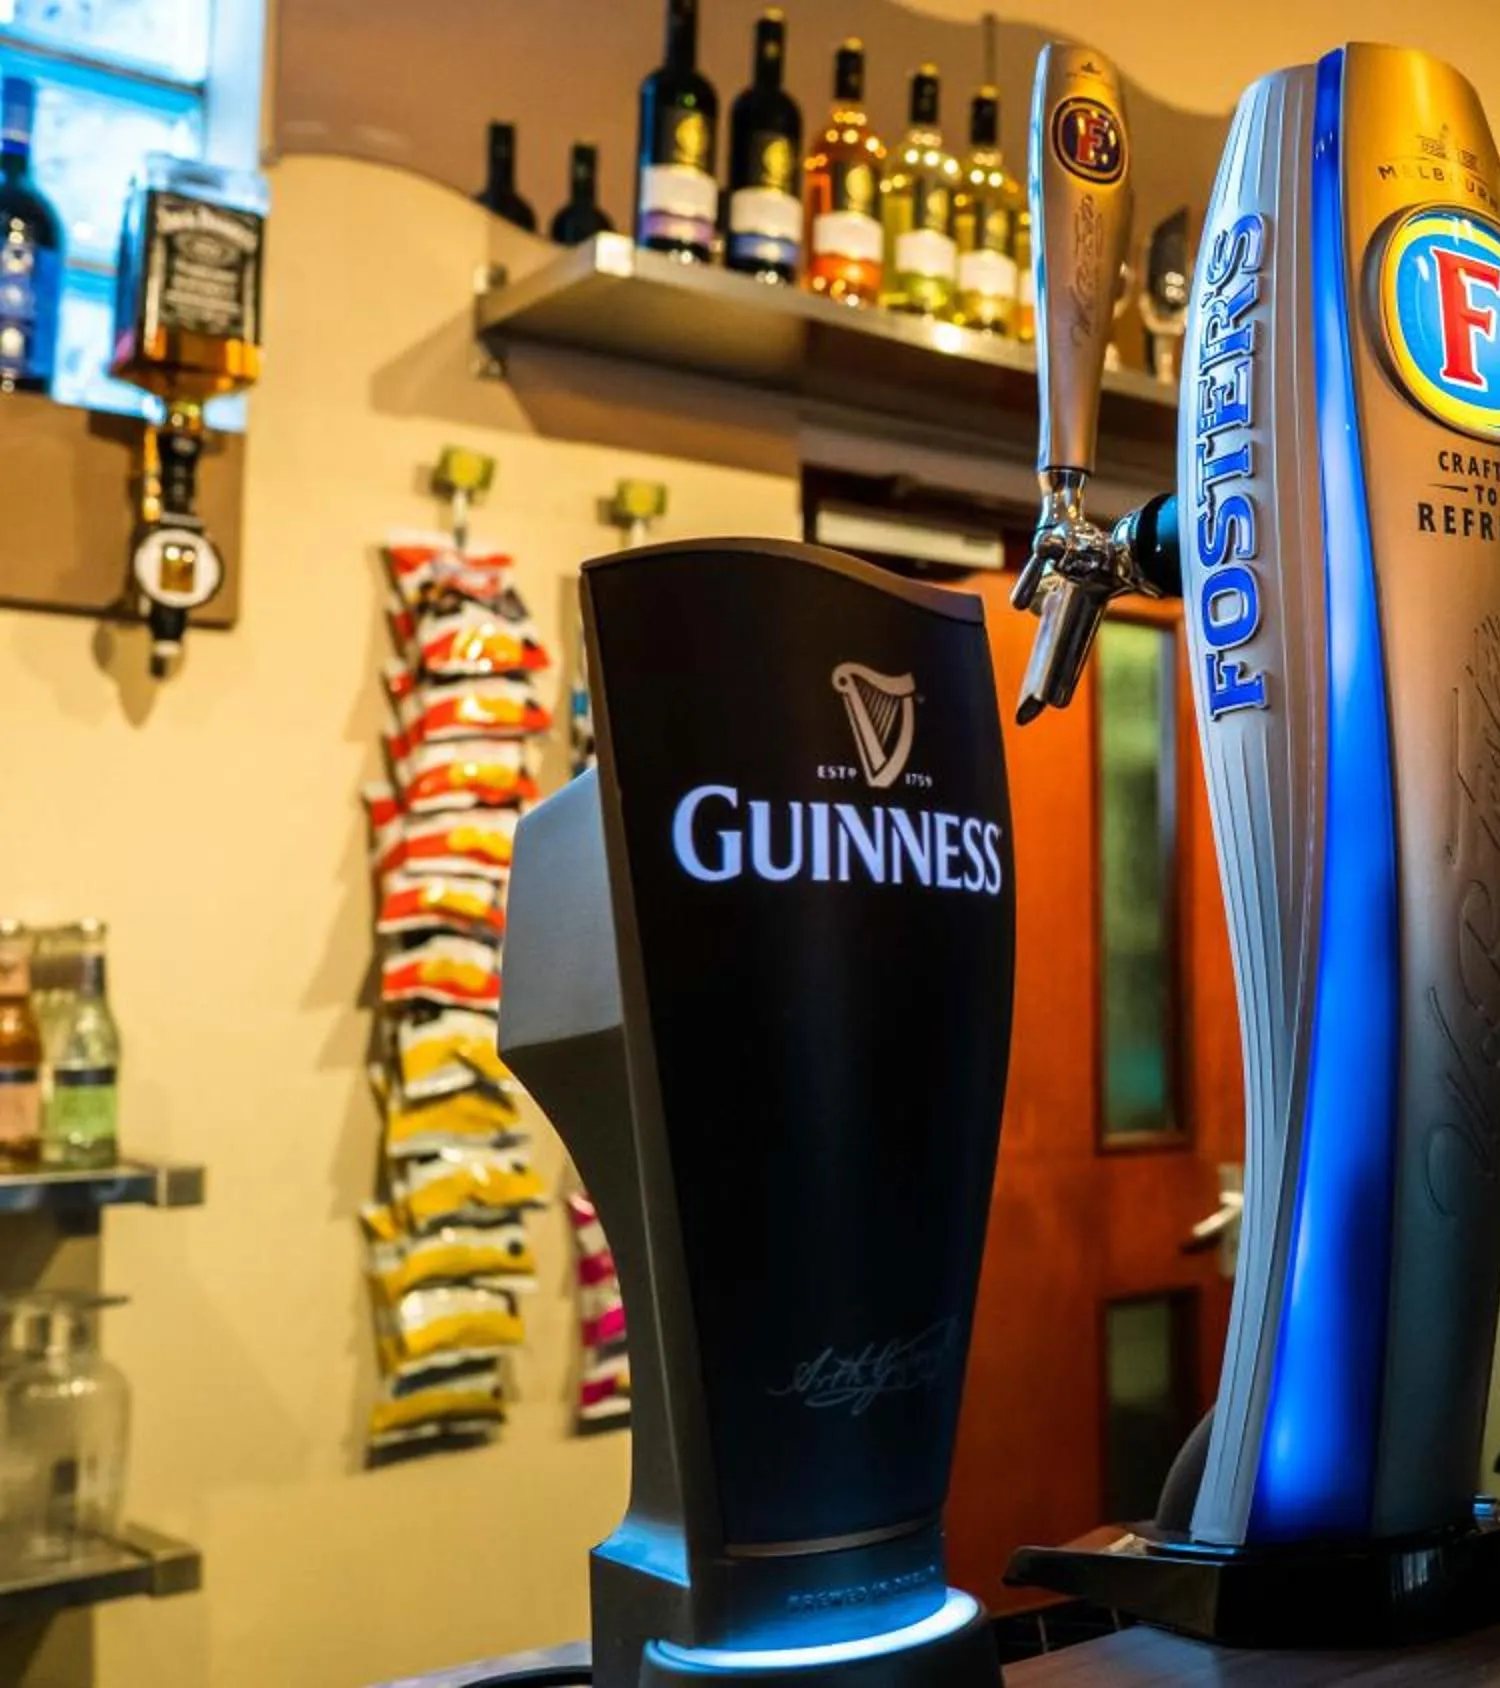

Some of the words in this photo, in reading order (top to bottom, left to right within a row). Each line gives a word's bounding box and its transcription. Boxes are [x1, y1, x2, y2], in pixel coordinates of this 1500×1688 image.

[1199, 212, 1269, 721] FOSTER'S
[1475, 484, 1497, 505] TO
[671, 784, 1001, 895] GUINNESS
